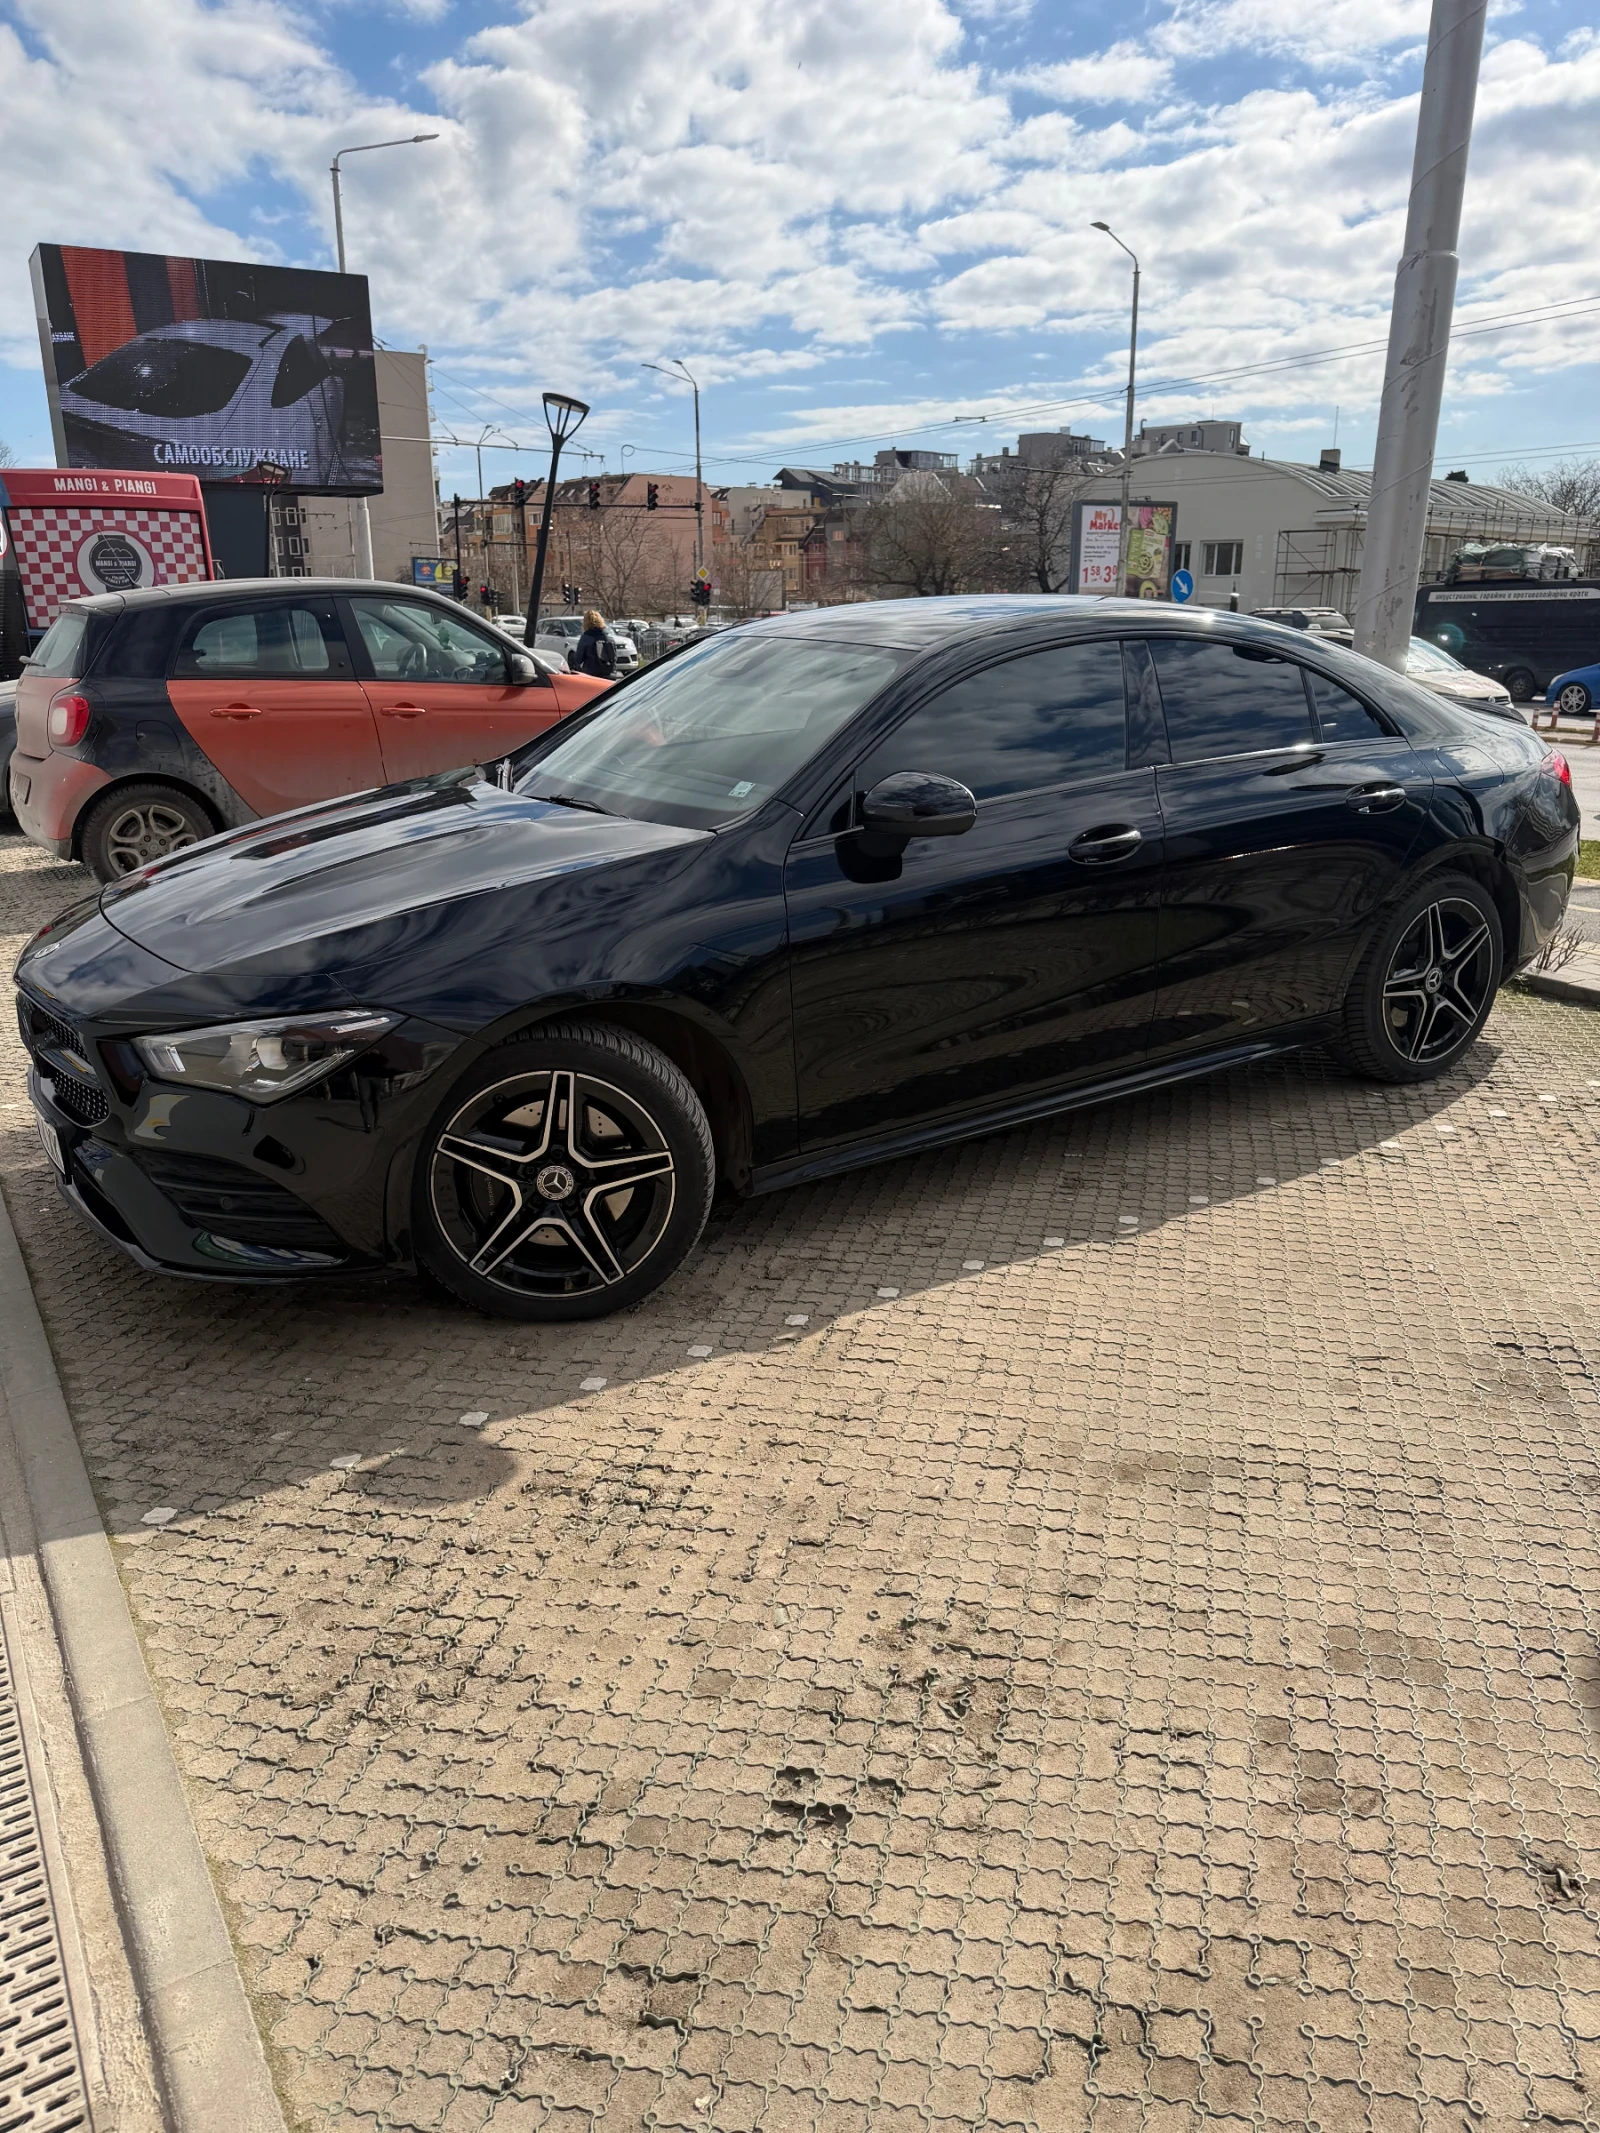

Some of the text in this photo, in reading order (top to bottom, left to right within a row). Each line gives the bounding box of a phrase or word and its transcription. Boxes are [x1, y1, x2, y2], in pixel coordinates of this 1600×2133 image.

[153, 443, 310, 469] САМООБСЛУЖВАНЕ
[53, 477, 157, 494] MANGI & PIANGI
[1094, 510, 1107, 523] My
[1089, 519, 1121, 530] Marke
